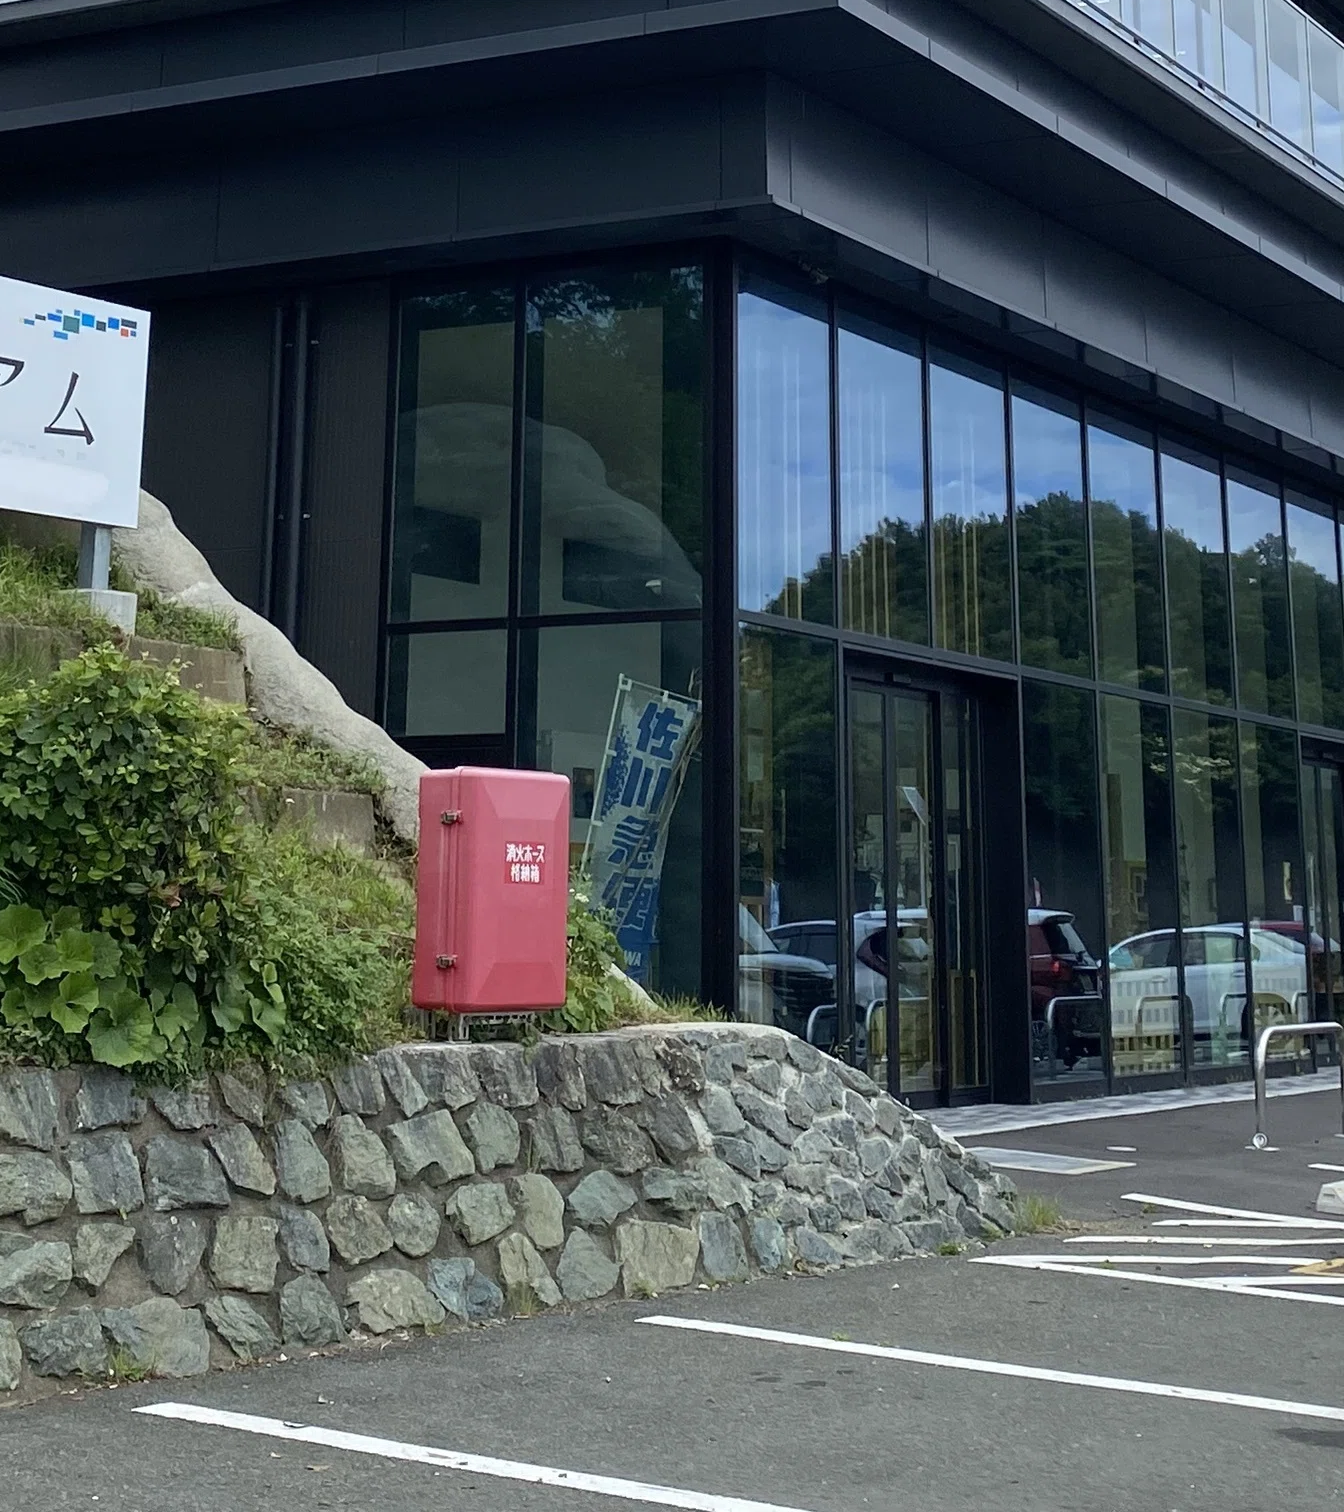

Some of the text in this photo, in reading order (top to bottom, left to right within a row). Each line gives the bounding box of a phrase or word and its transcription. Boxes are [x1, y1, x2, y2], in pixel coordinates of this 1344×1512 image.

[506, 843, 545, 863] 消火ホース
